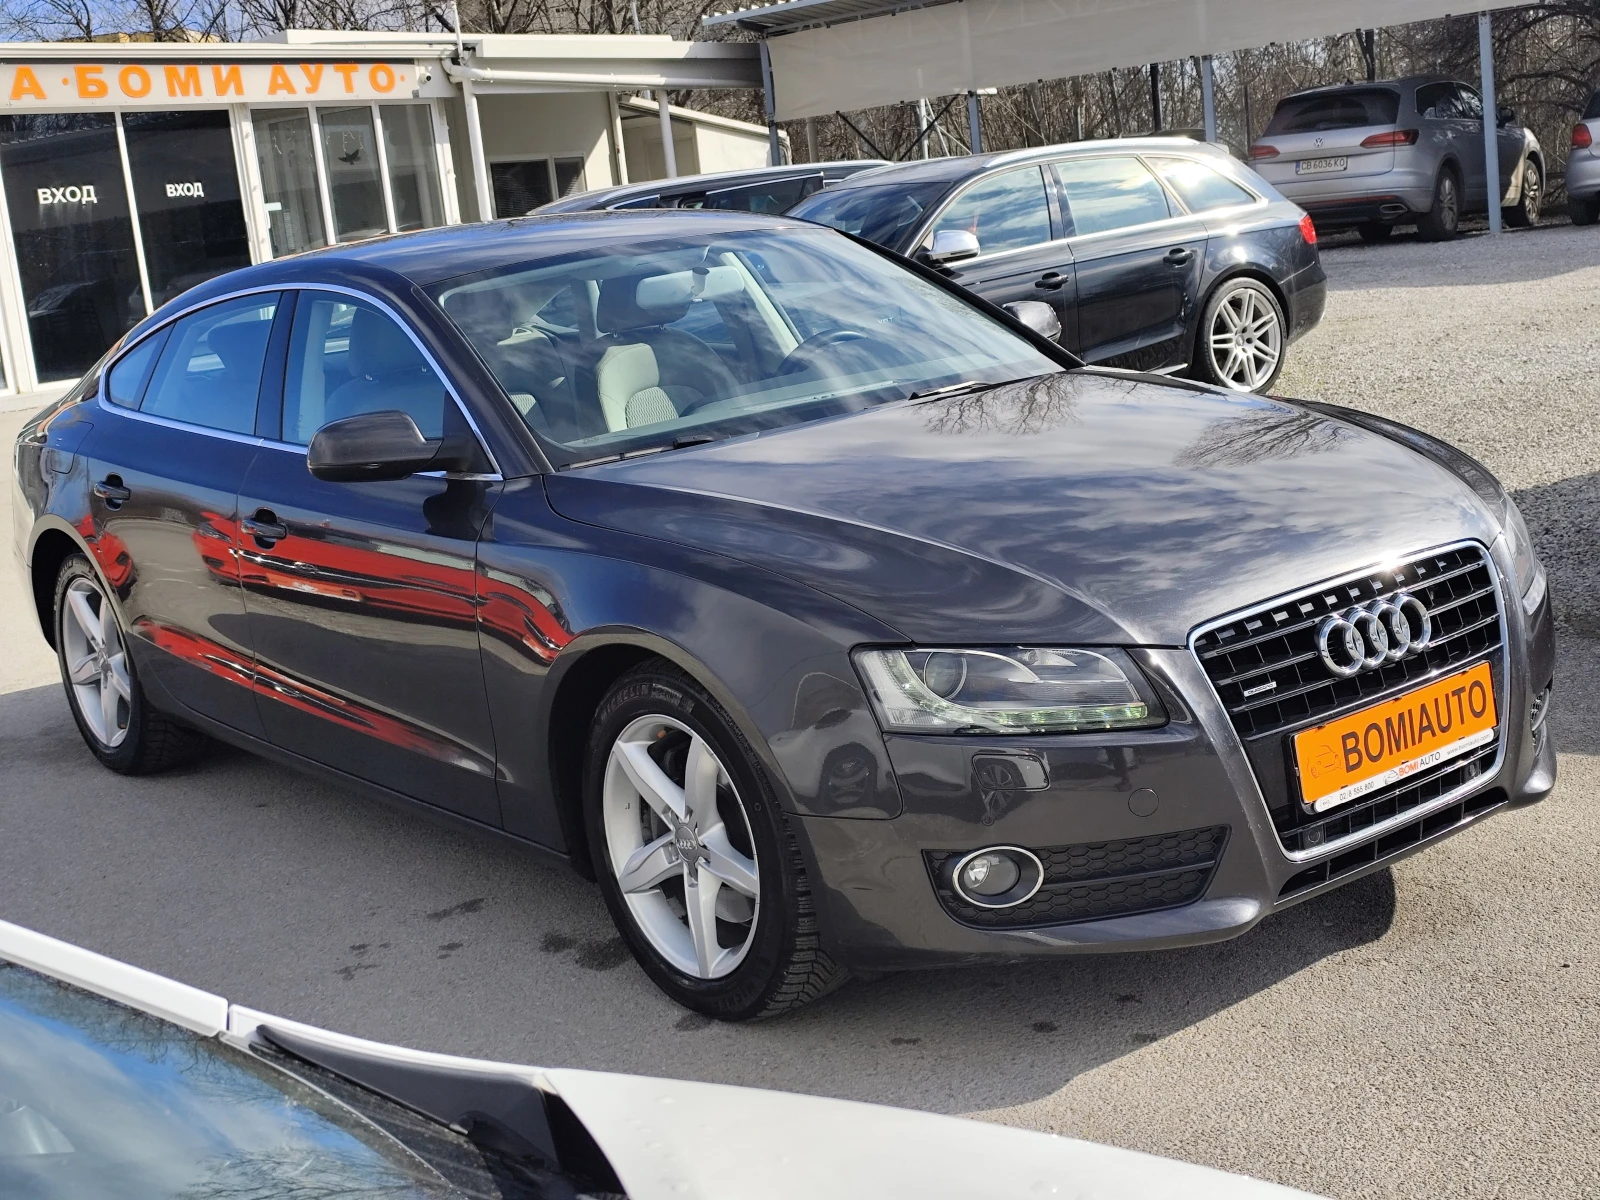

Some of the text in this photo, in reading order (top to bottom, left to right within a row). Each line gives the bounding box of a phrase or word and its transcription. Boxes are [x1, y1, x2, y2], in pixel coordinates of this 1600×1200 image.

[74, 64, 245, 98] БОМИ
[268, 62, 396, 96] АУТО
[1313, 160, 1333, 170] 6036
[37, 185, 98, 205] ВХОД
[165, 182, 204, 198] ВХОД
[1341, 679, 1487, 774] BOMIAUTO
[1398, 760, 1419, 777] BOMI
[1419, 751, 1441, 768] AUTO
